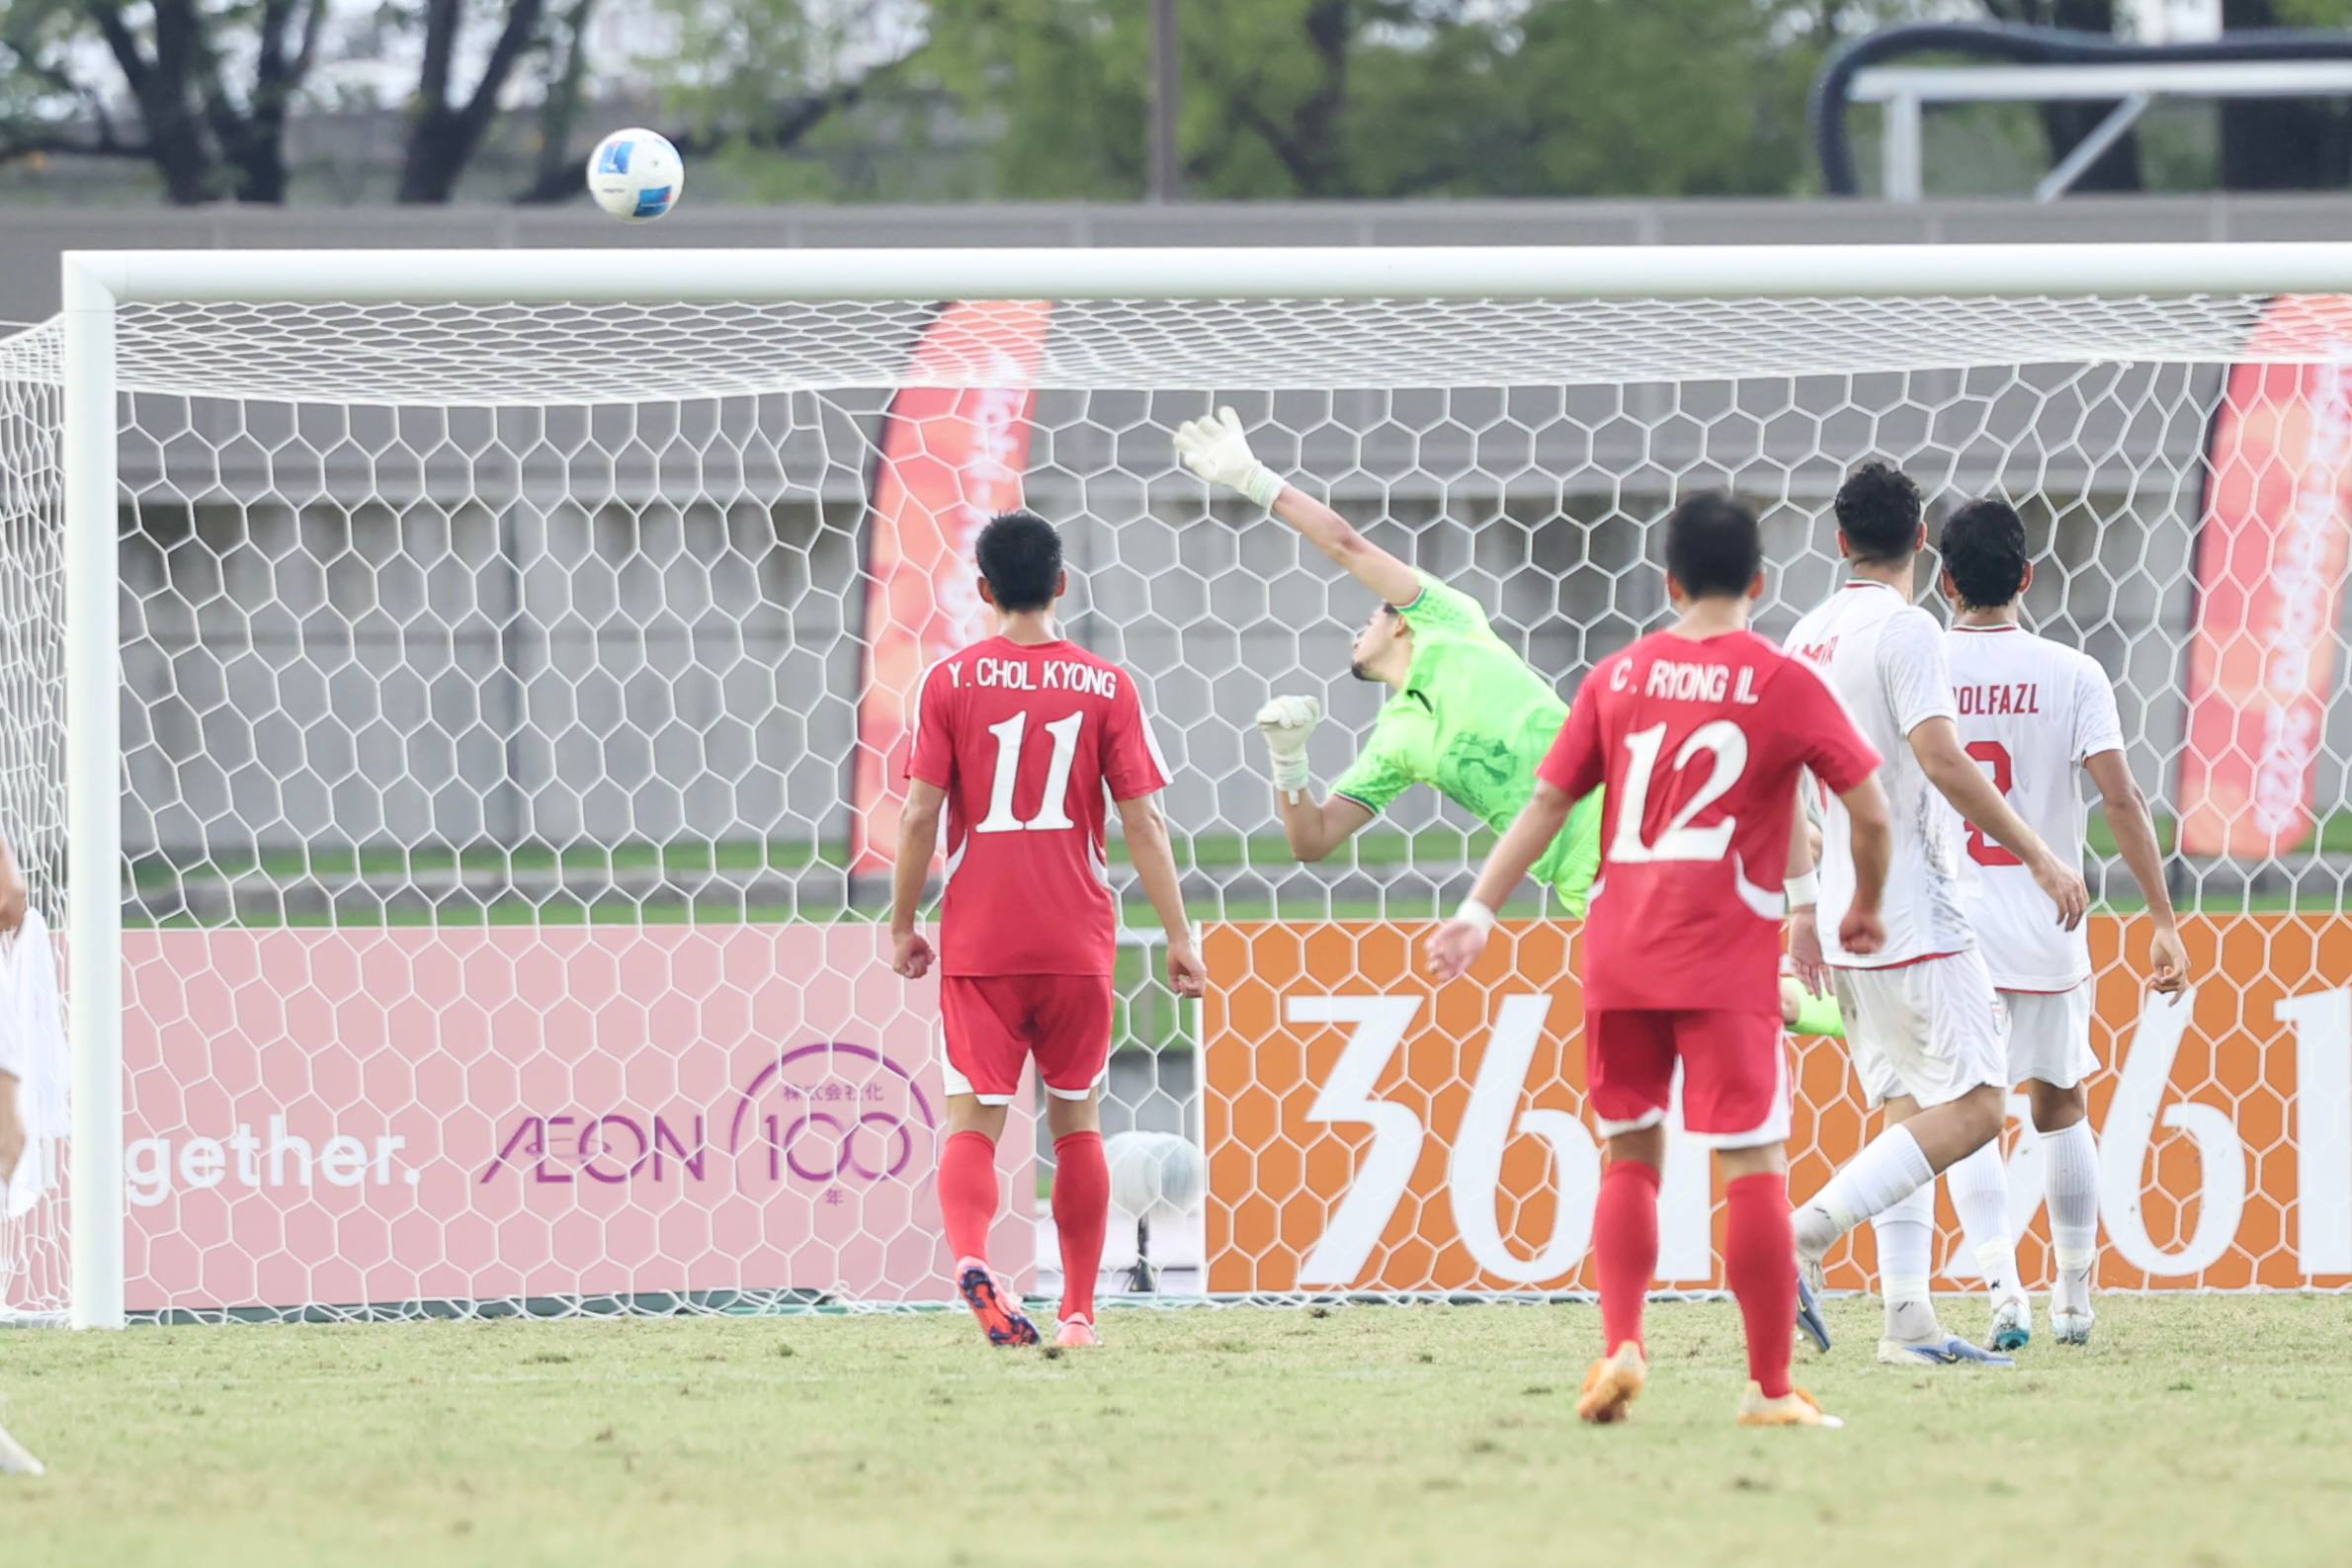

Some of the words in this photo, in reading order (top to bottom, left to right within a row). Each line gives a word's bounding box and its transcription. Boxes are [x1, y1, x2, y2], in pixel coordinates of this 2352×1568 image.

[948, 660, 972, 689] Y.
[976, 657, 1038, 691] CHOL
[1042, 659, 1118, 701] KYONG
[1609, 658, 1638, 695] C.
[1644, 659, 1728, 702] RYONG
[1733, 665, 1759, 704] IL
[1953, 683, 2040, 715] OLFAZL
[974, 709, 1084, 834] 11
[1608, 718, 1749, 863] 12
[764, 1112, 912, 1182] 100
[826, 1189, 844, 1206] 年
